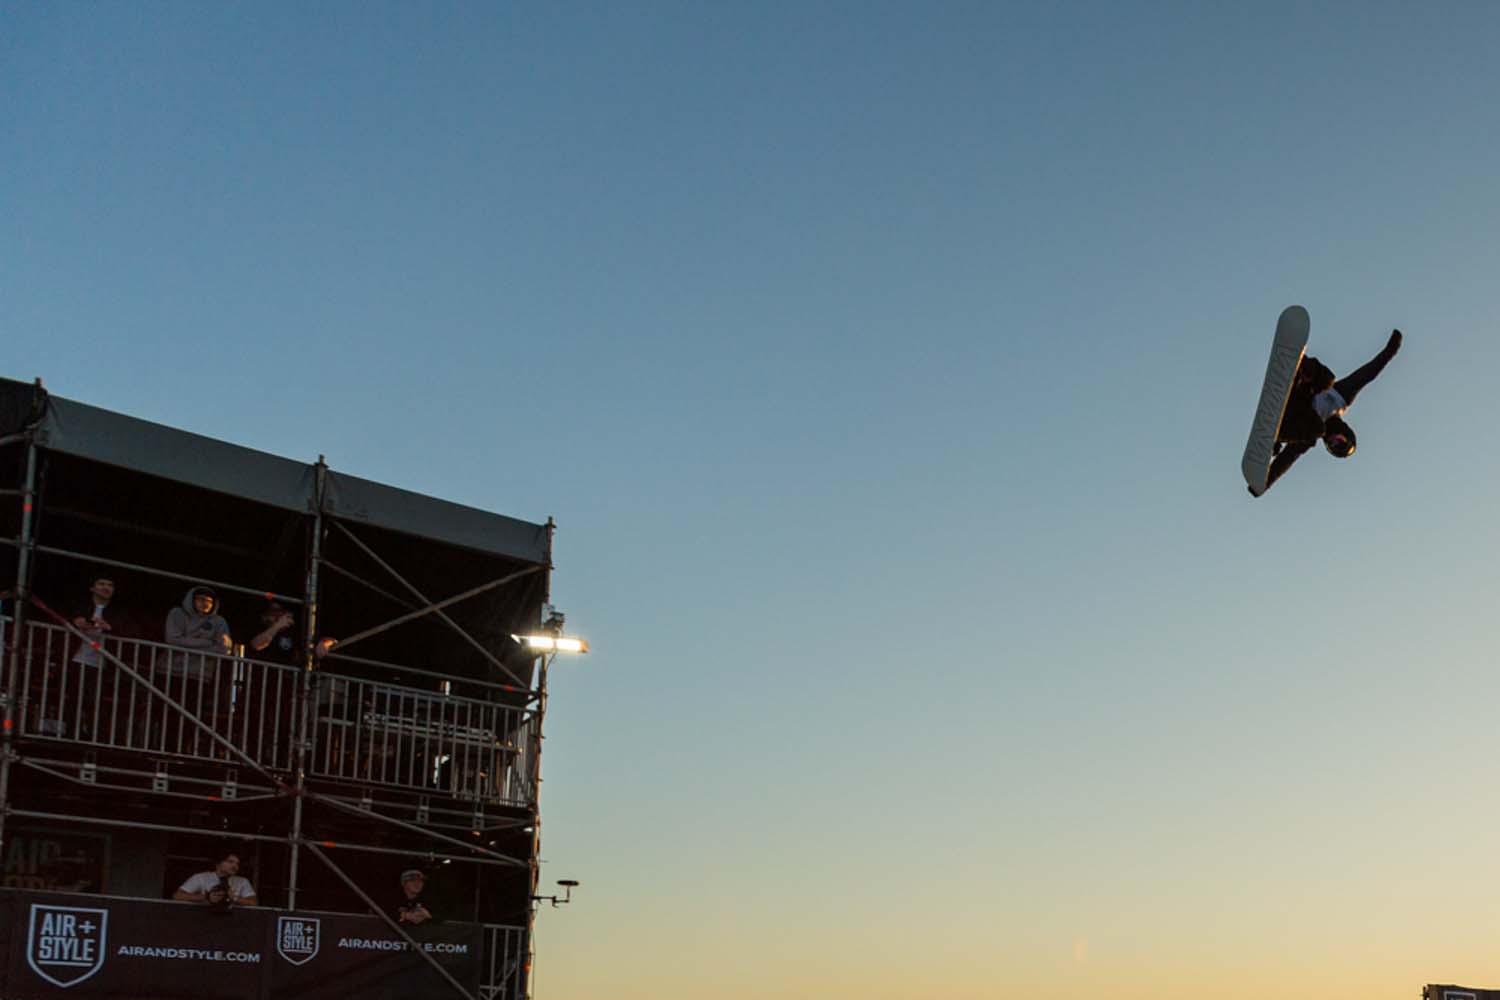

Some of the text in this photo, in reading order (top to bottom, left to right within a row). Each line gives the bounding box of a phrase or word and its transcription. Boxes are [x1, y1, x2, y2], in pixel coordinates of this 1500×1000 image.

[40, 912, 97, 937] AIR+
[283, 921, 314, 936] AIR+
[38, 936, 96, 961] STYLE
[283, 935, 313, 950] STYLE
[338, 937, 468, 953] AIRANDSTE.COM
[118, 946, 261, 963] AIRANDSTYLE.COM
